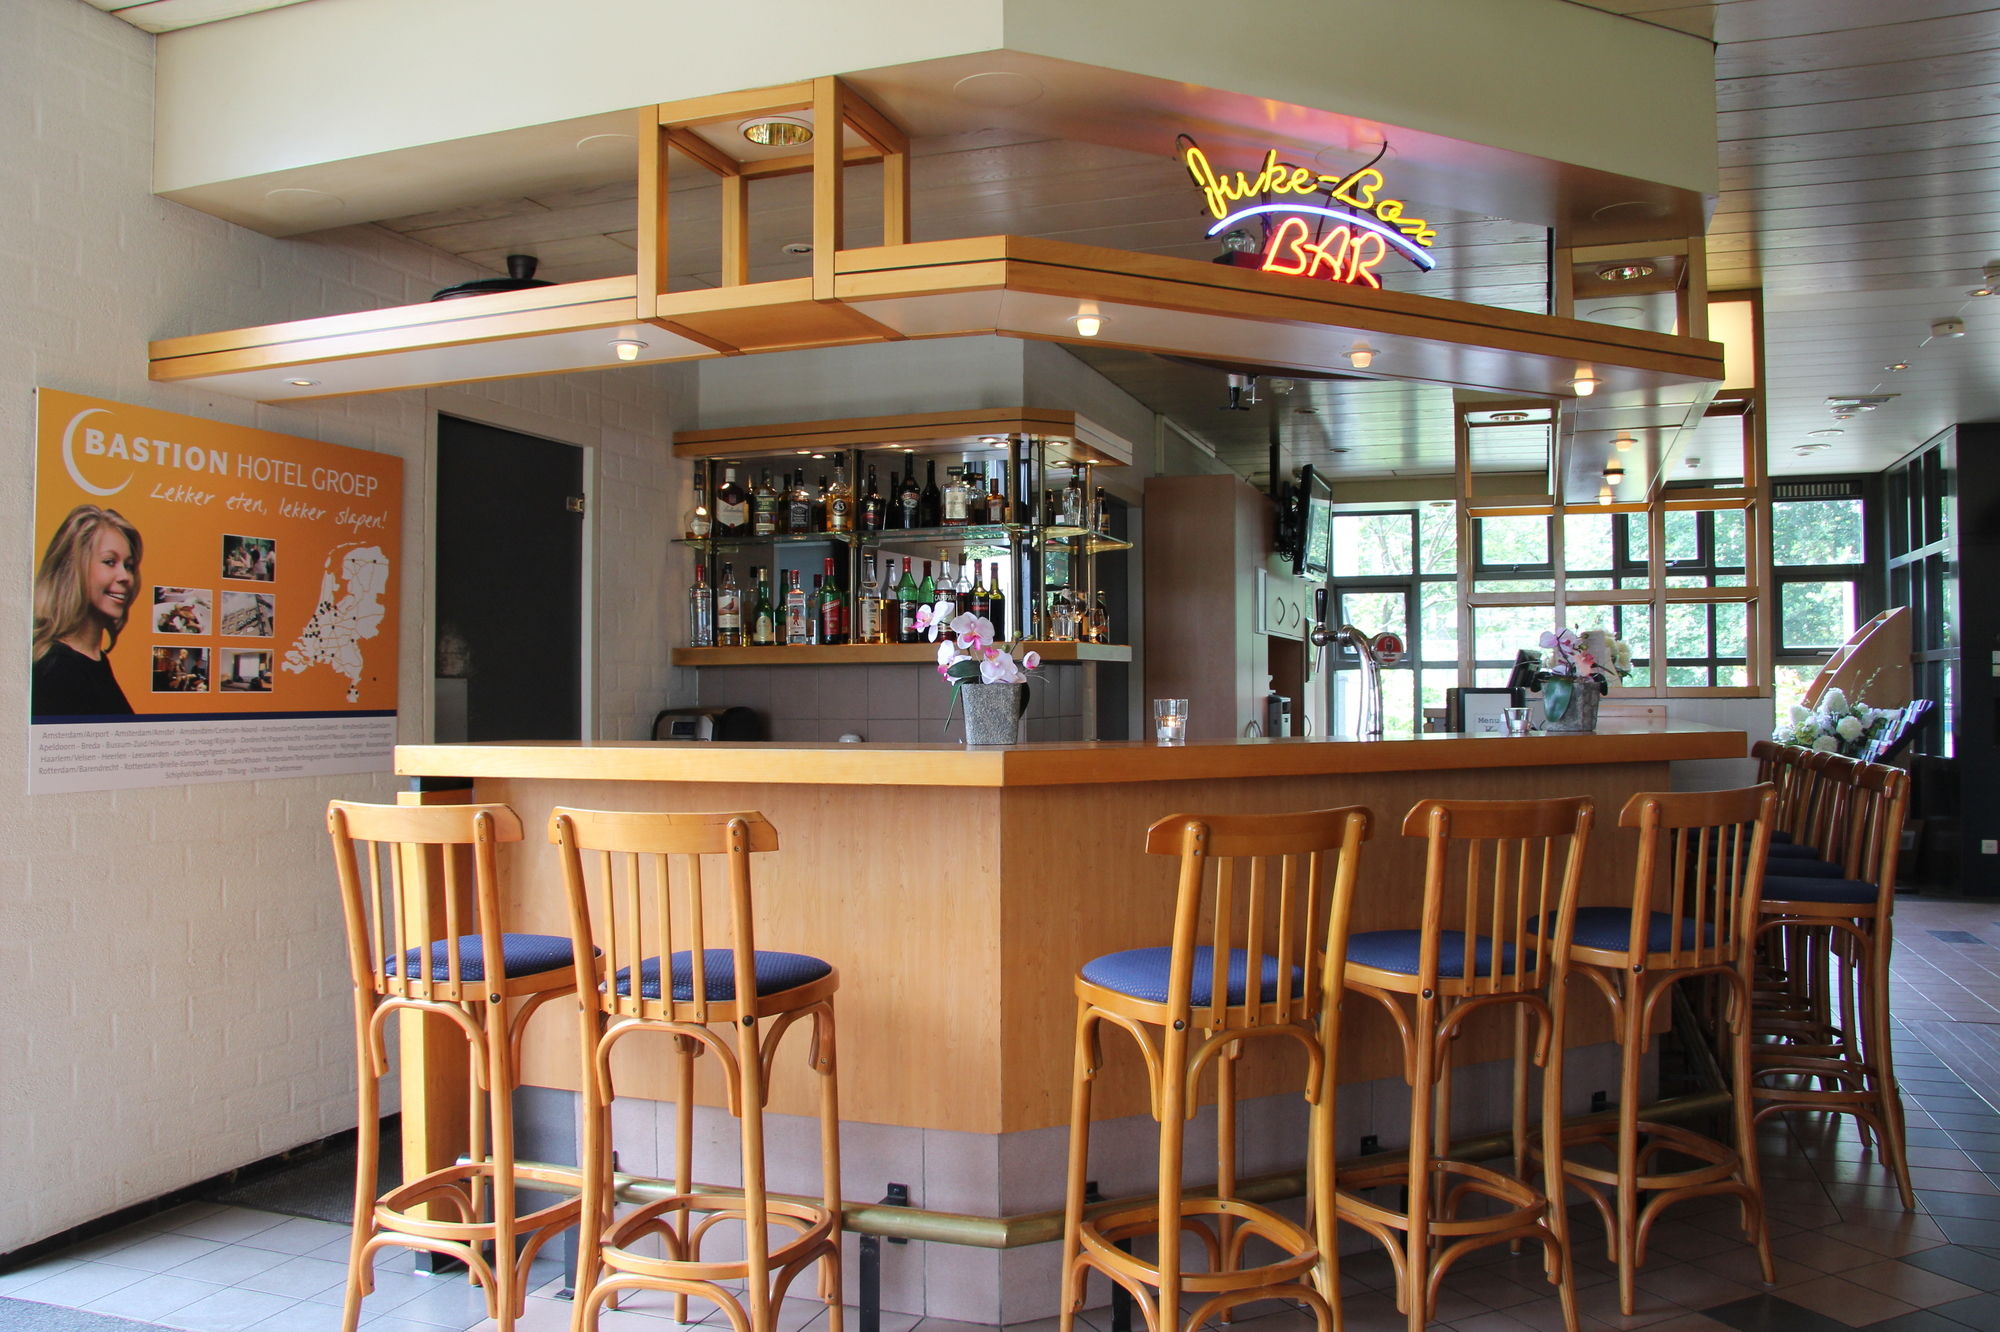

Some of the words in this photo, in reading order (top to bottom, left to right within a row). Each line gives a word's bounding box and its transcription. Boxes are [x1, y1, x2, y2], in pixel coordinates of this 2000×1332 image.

[1262, 217, 1386, 289] BAR
[84, 428, 228, 475] BASTION
[237, 455, 307, 488] HOTEL
[312, 467, 378, 498] GROEP
[150, 482, 215, 506] Lekker
[226, 495, 267, 516] eten,
[279, 498, 326, 520] lekker
[335, 511, 388, 534] slapen!
[1478, 717, 1501, 725] Menu
